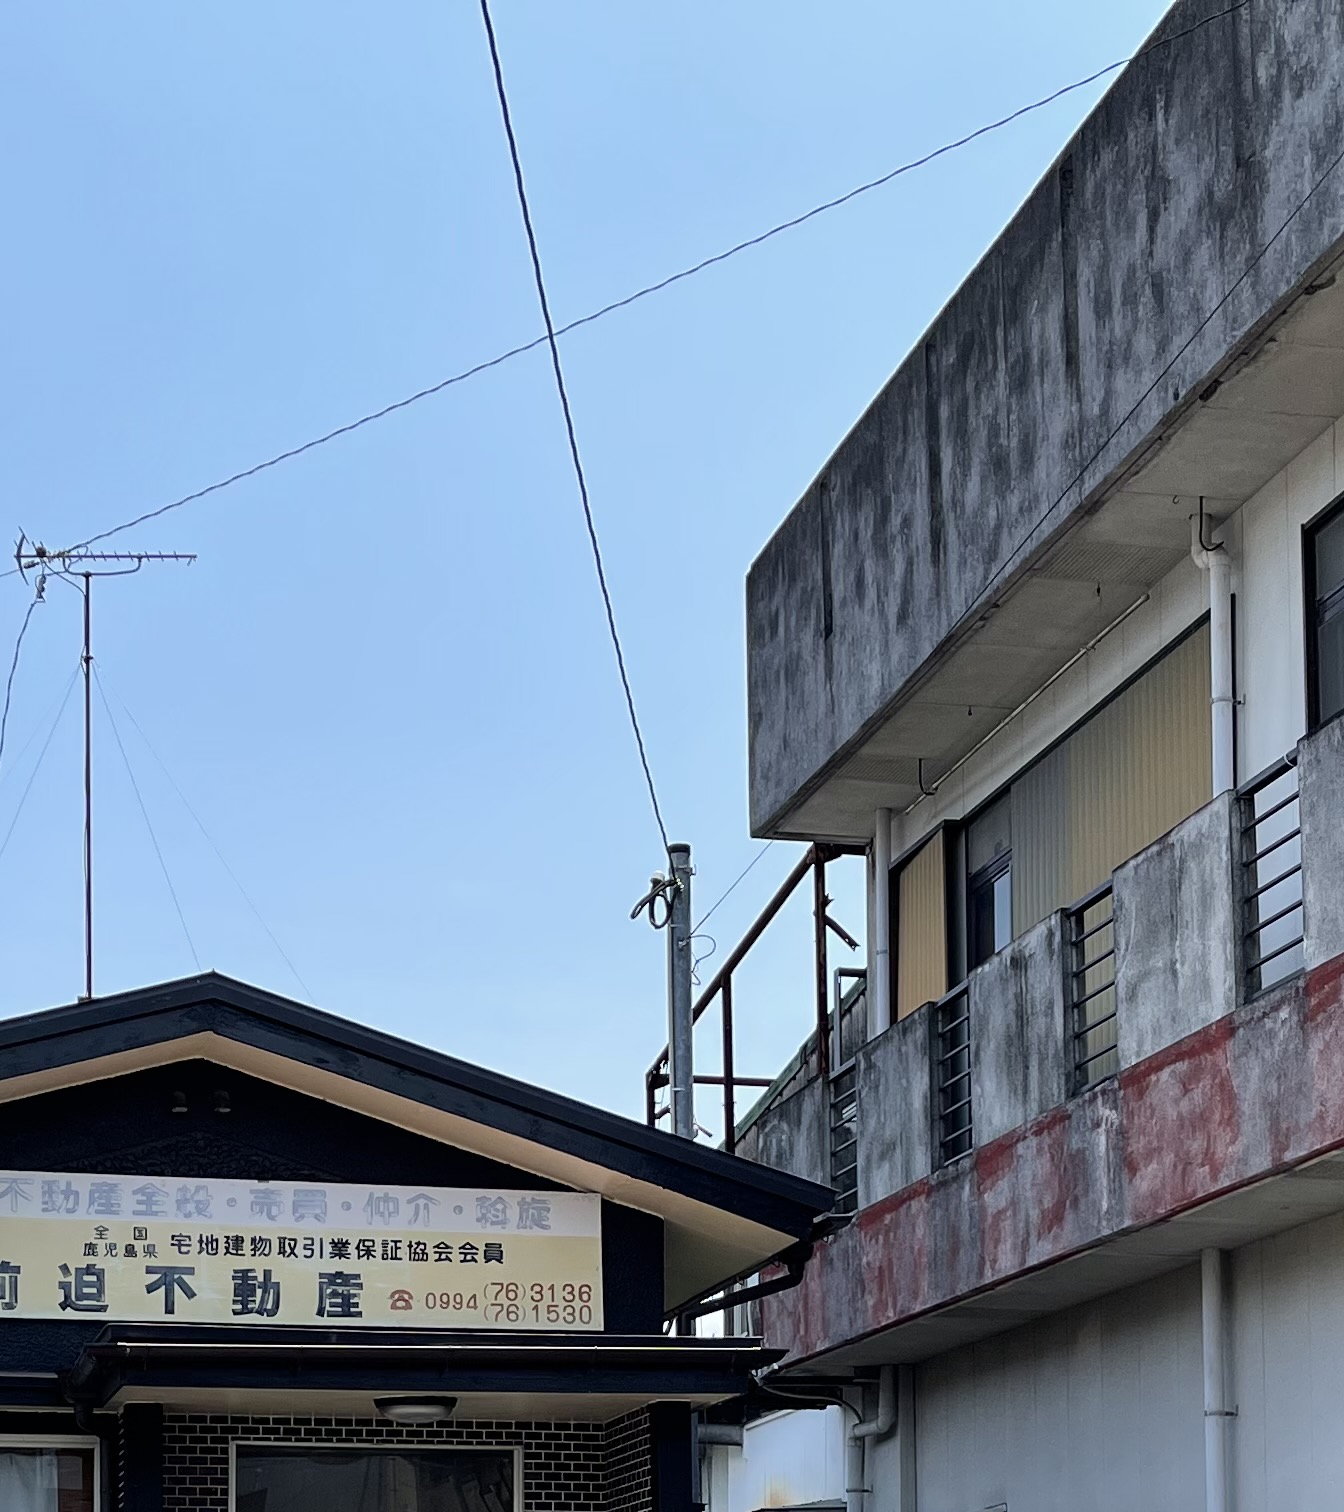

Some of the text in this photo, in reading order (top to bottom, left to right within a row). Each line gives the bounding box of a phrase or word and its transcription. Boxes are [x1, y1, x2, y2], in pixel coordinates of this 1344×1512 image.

[83, 1242, 158, 1259] 鹿児島県
[169, 1232, 505, 1265] 宅地建物取引業保証協会会員
[424, 1281, 593, 1312] 0994 (76)3136
[482, 1303, 593, 1325] (76)1530
